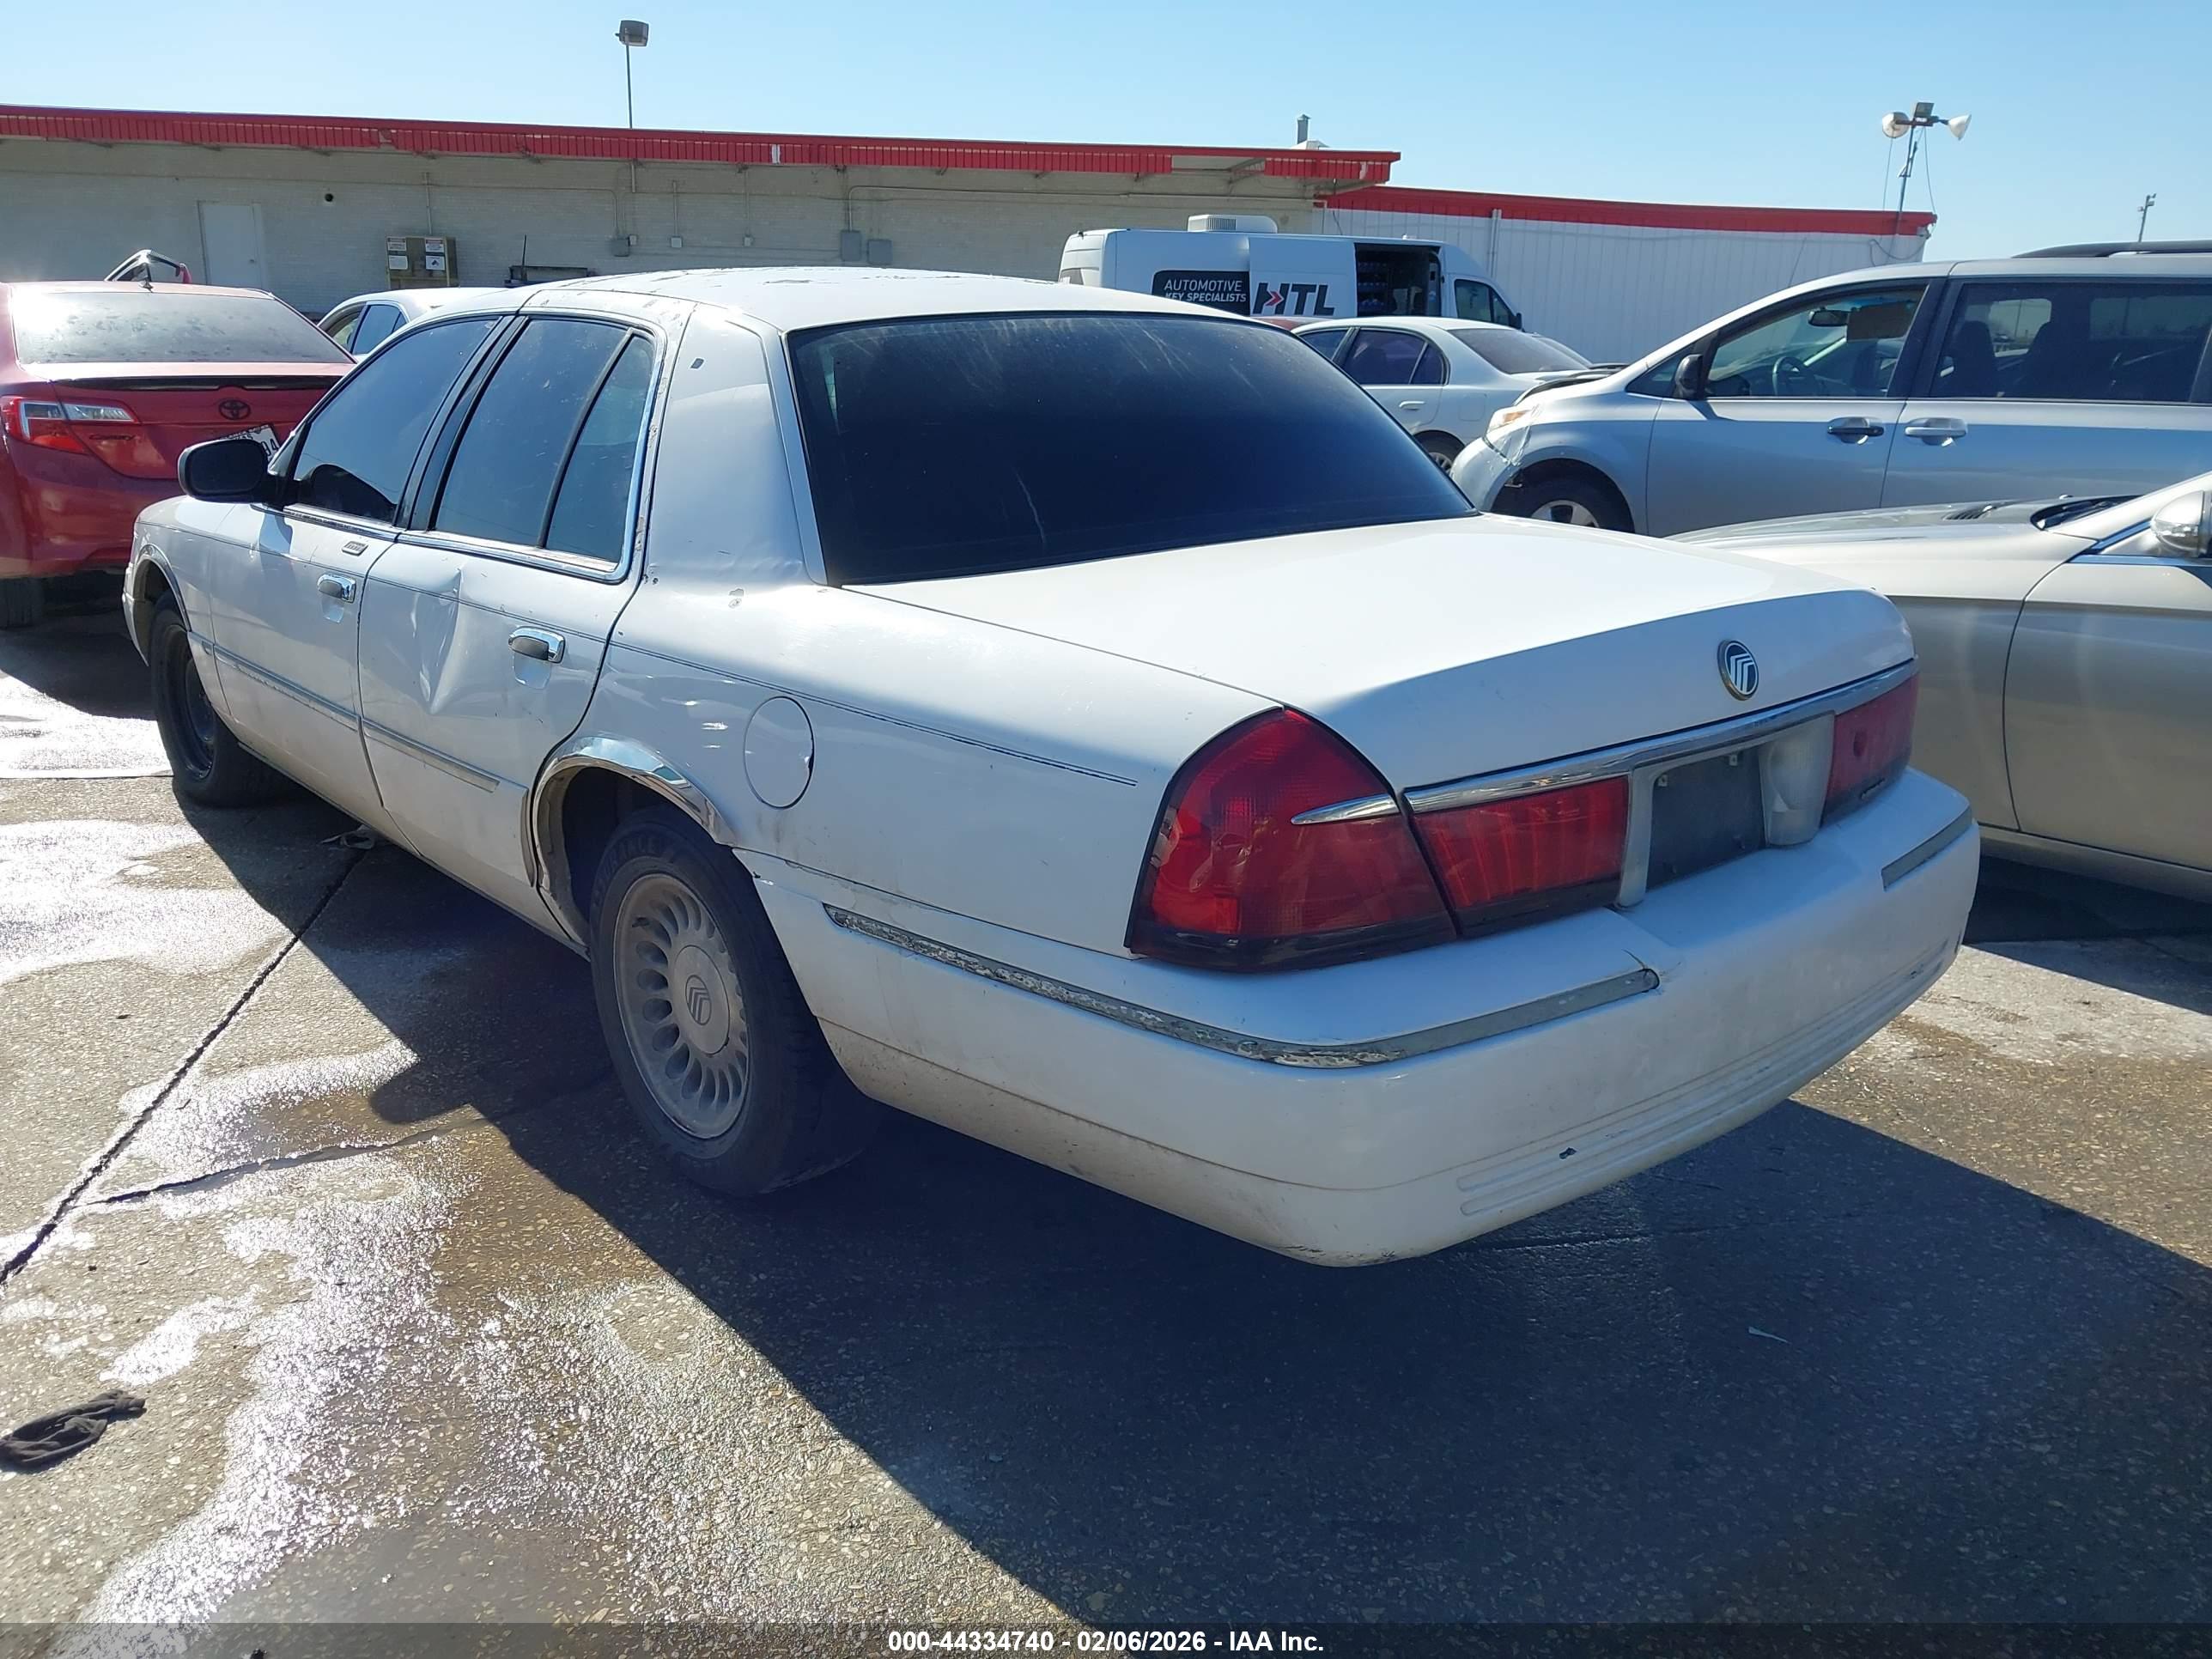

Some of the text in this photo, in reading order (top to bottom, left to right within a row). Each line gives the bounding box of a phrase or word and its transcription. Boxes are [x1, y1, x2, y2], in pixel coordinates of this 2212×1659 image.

[1164, 279, 1243, 292] AUTOMOTIVE
[1187, 292, 1247, 302] SPECIALISTS
[1253, 282, 1335, 316] HTL
